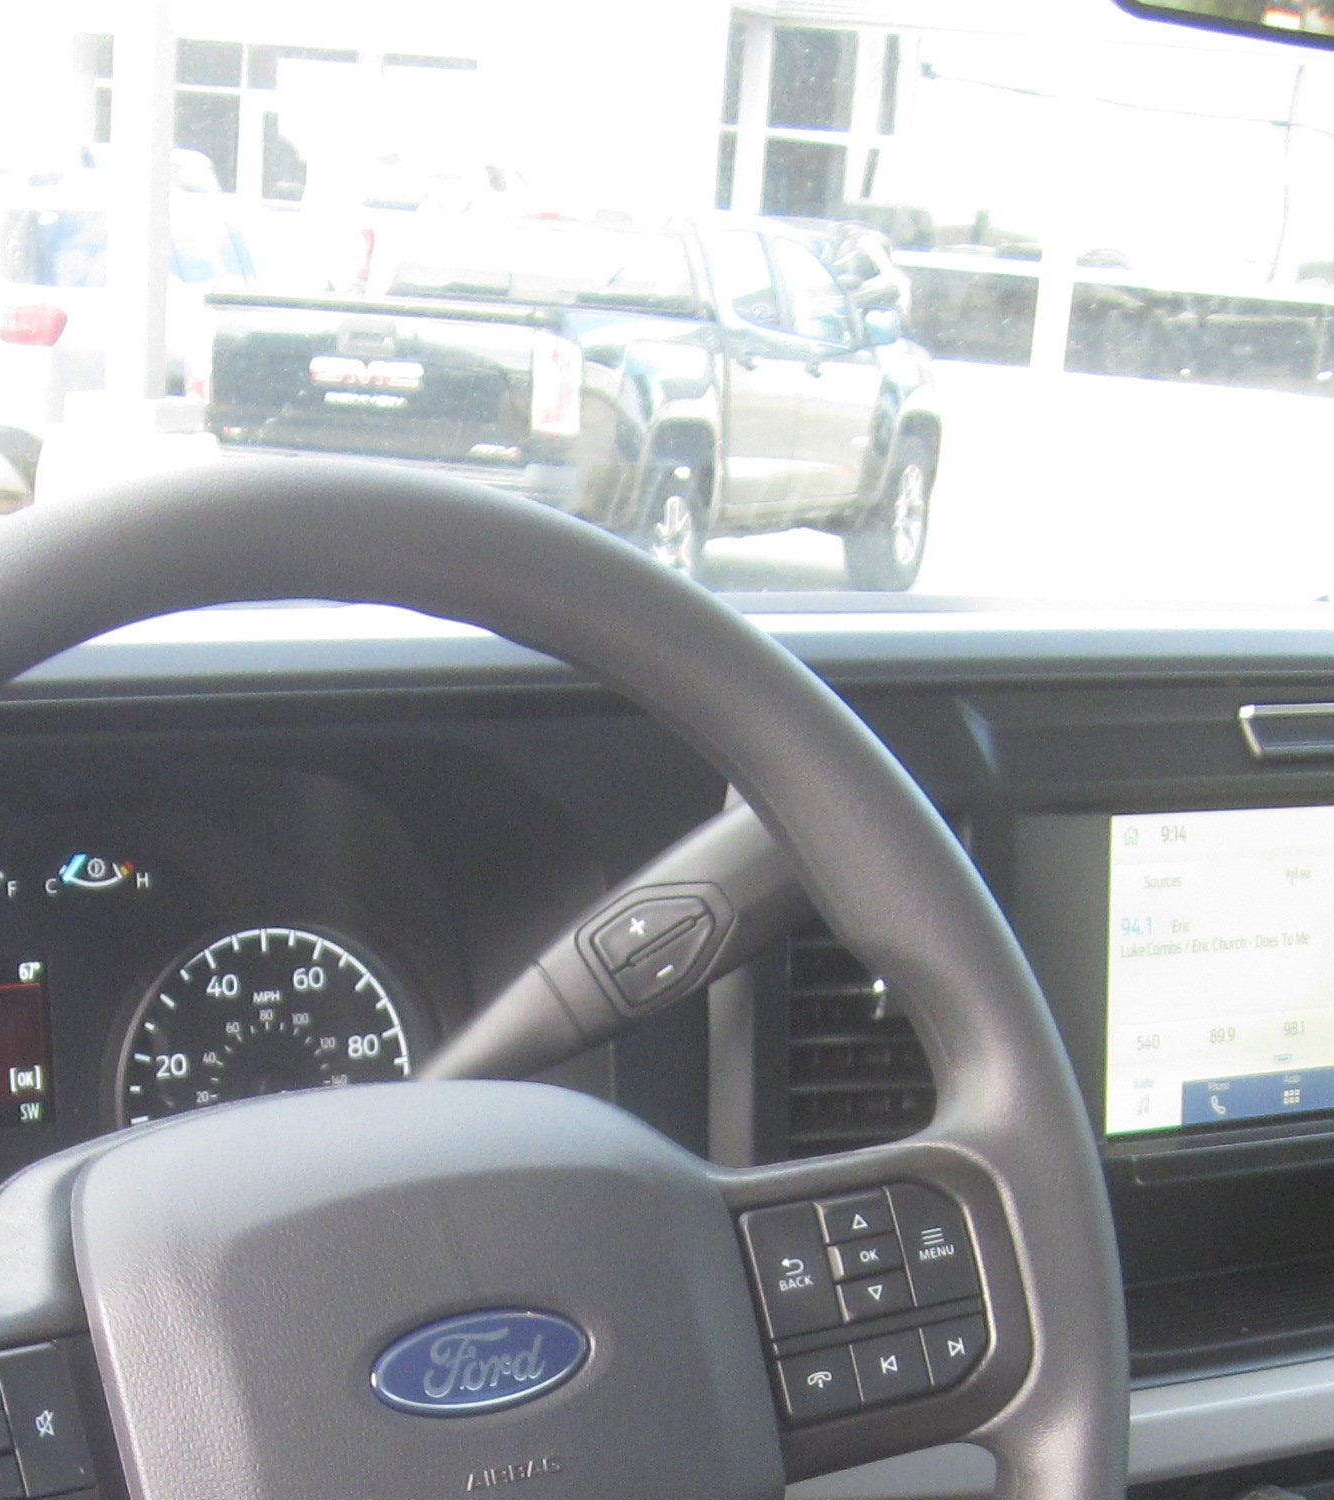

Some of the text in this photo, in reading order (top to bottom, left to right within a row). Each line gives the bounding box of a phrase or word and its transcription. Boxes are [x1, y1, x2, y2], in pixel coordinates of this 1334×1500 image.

[1160, 826, 1187, 844] 9:14
[7, 880, 18, 897] F
[44, 877, 58, 896] C
[135, 872, 150, 890] H
[1120, 916, 1154, 936] 94.1
[205, 973, 240, 999] 40
[292, 966, 326, 992] 60
[252, 989, 281, 1005] MPH
[347, 1033, 380, 1059] 80
[155, 1053, 188, 1079] 20
[19, 1103, 41, 1122] SW
[859, 1248, 880, 1263] OK
[918, 1244, 955, 1261] MENU
[779, 1274, 815, 1292] BACK
[423, 1326, 548, 1399] Ford
